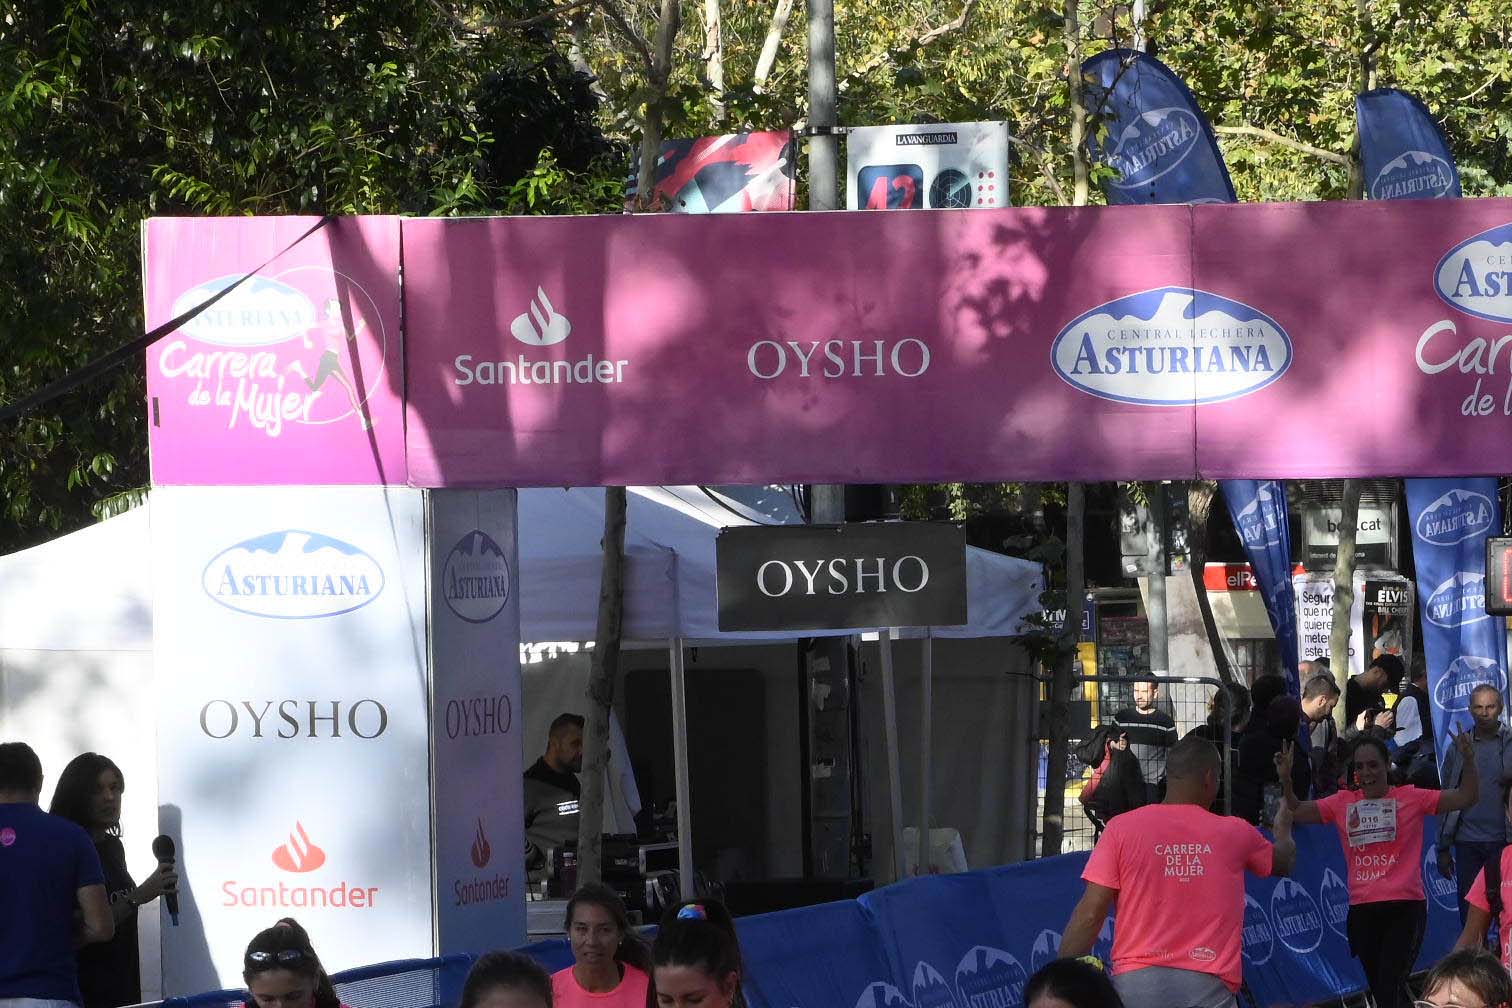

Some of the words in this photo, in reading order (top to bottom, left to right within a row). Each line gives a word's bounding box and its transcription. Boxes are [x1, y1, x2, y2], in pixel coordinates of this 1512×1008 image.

[1107, 327, 1182, 341] CENTRAL
[1190, 326, 1266, 340] LECHERA
[159, 341, 278, 379] Carrera
[454, 353, 629, 386] Santander
[747, 337, 931, 380] OYSHO
[1071, 337, 1274, 378] ASTURIANA
[187, 378, 211, 406] de
[215, 376, 232, 406] la
[228, 374, 323, 438] Mujer
[1461, 376, 1494, 416] de
[217, 564, 372, 597] ASTURIANA
[448, 566, 506, 600] ASTURIANA
[756, 554, 930, 599] OYSHO
[1377, 589, 1408, 603] ELVIS
[200, 698, 389, 740] OYSHO
[445, 694, 512, 740] OYSHO
[1155, 843, 1212, 855] CARRERA
[1166, 855, 1182, 866] DE
[1186, 855, 1202, 865] LA
[1164, 866, 1205, 877] MUJER
[222, 881, 379, 909] Santander
[454, 875, 510, 906] Santander
